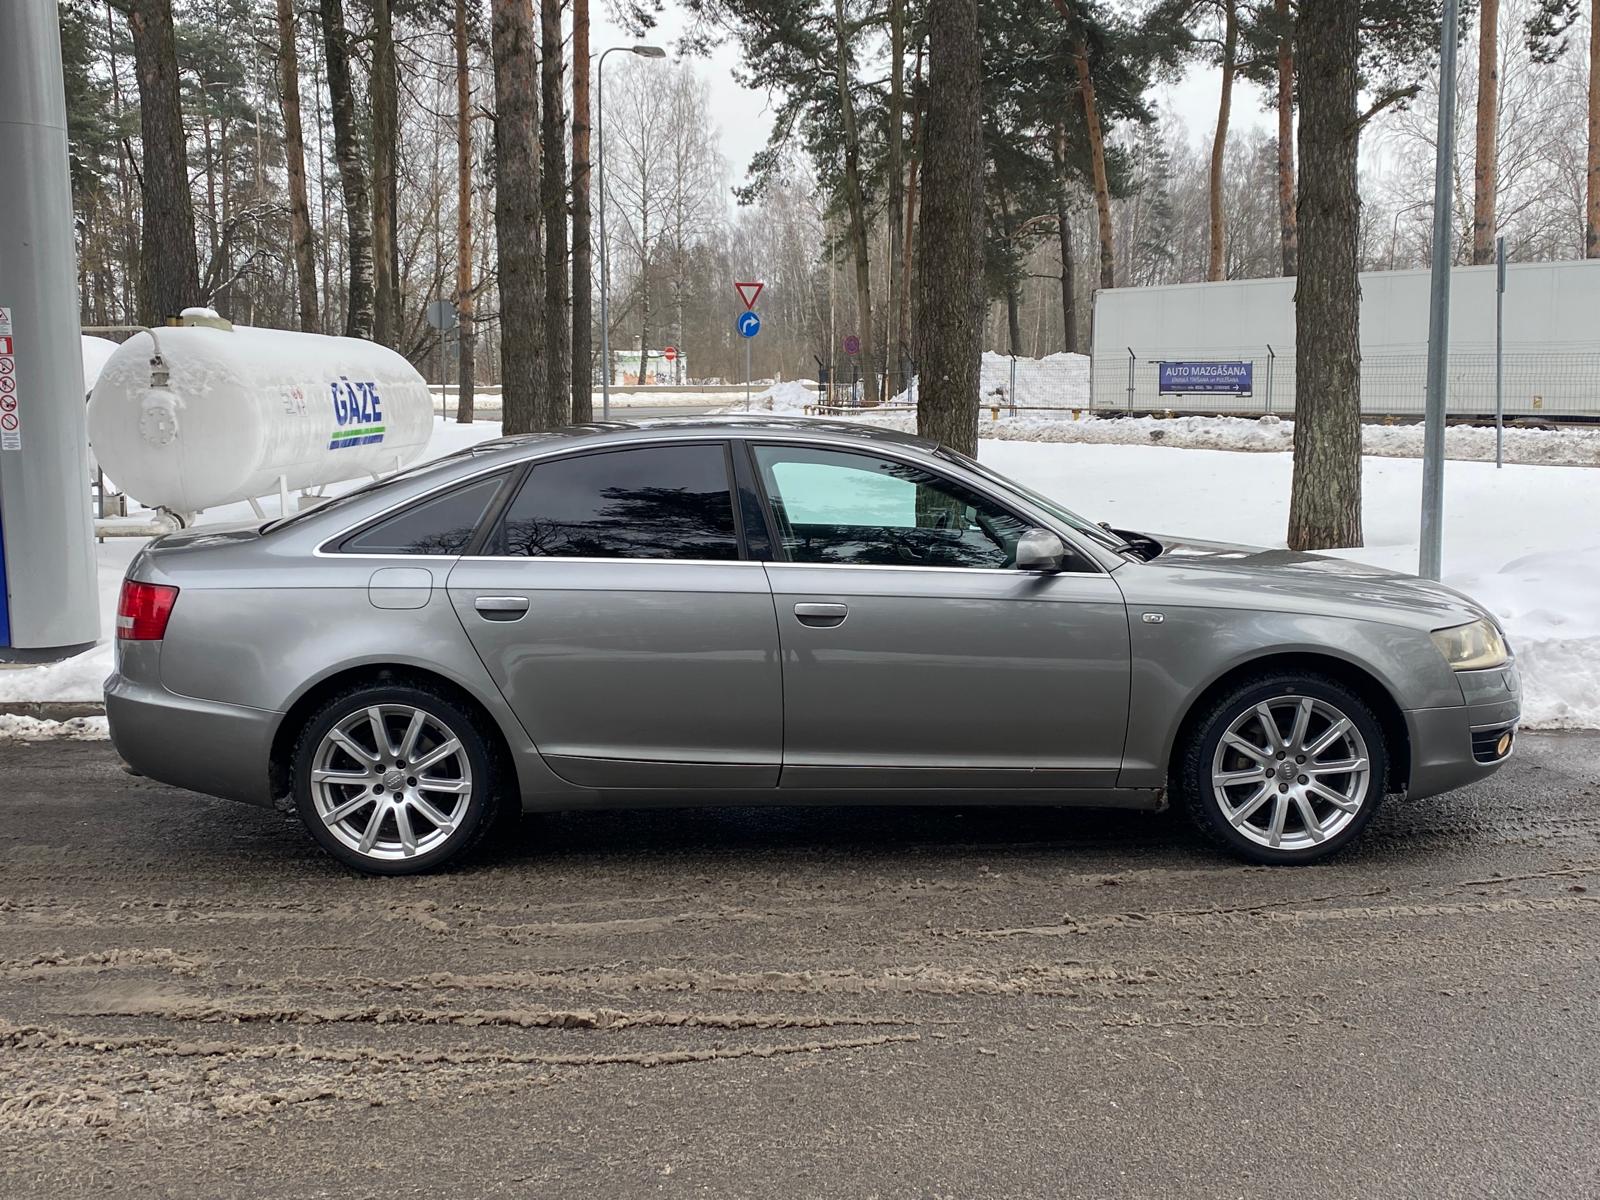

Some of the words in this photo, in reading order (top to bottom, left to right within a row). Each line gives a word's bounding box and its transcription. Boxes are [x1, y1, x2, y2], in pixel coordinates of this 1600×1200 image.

[1165, 367, 1189, 376] AUTO
[1191, 365, 1247, 376] MAZGĀŠANA
[330, 376, 382, 426] GĀZE
